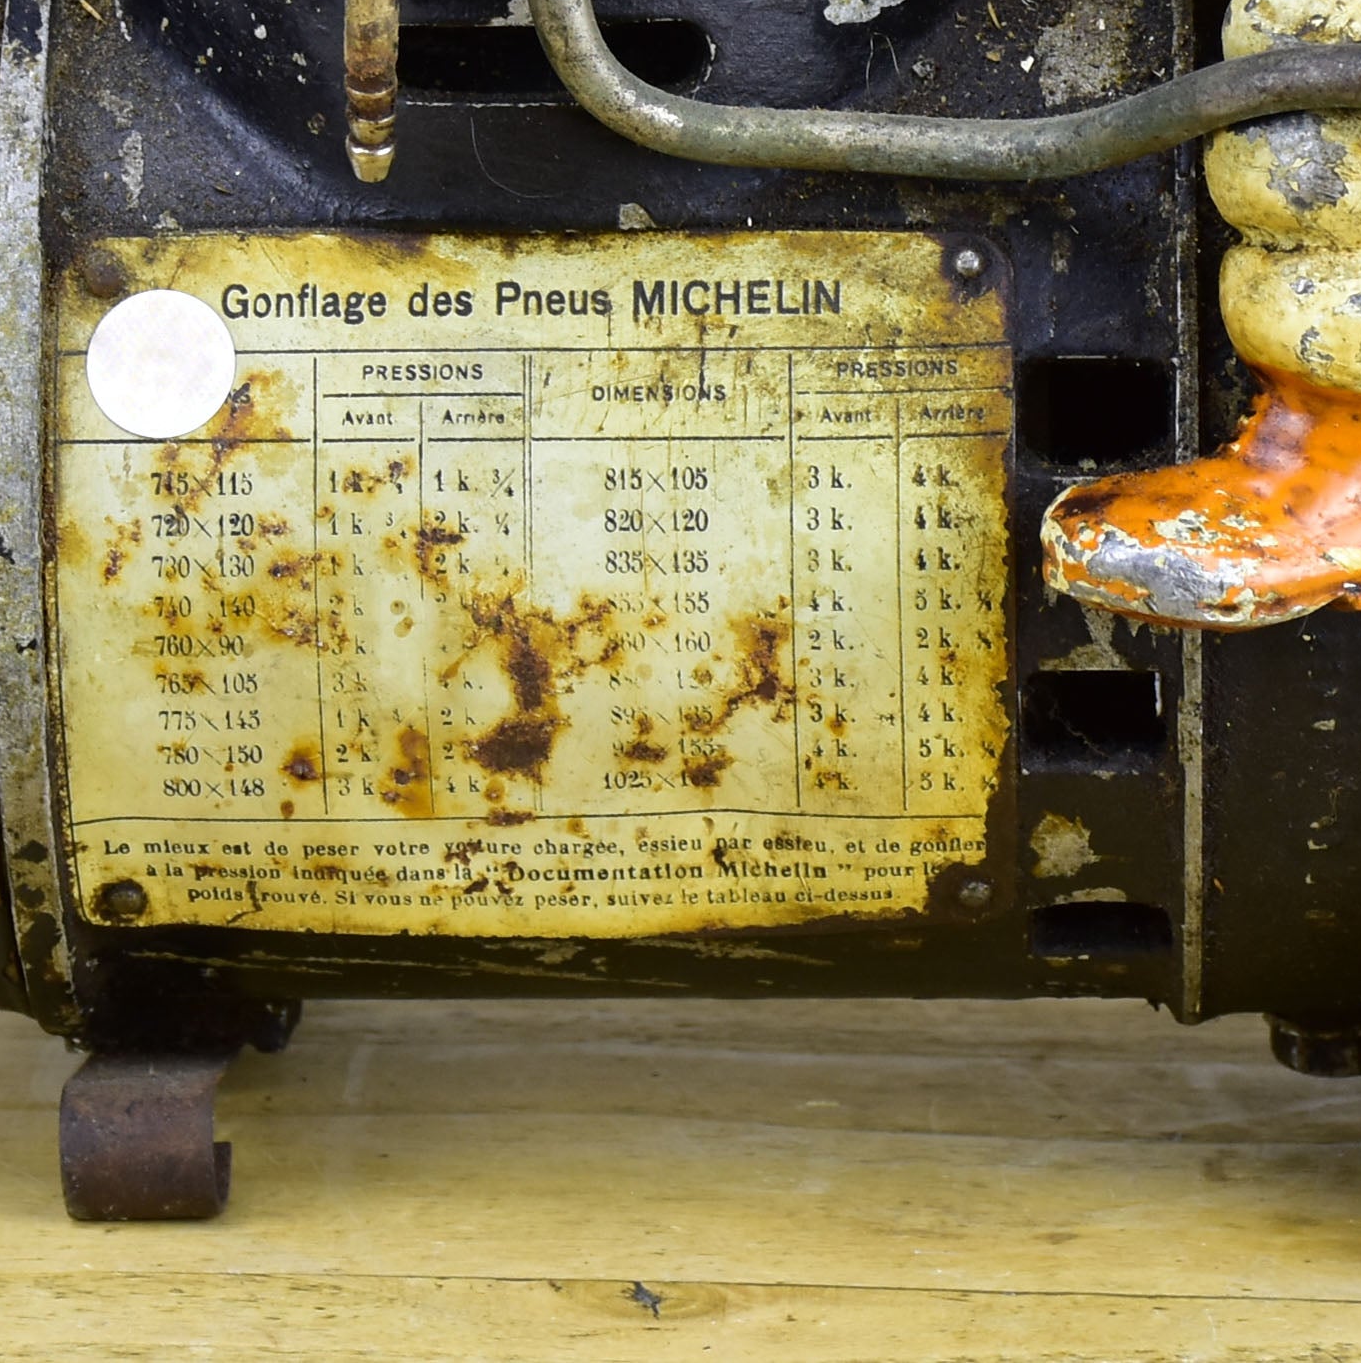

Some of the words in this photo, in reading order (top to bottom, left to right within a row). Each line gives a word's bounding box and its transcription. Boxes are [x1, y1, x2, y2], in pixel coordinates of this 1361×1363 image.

[221, 282, 388, 325] Gonflage
[407, 282, 474, 318] des
[495, 280, 613, 318] Pneus
[632, 279, 842, 317] MICHELIN
[361, 363, 485, 382] PRESSIONS
[836, 359, 959, 379] PRESSIONS
[591, 384, 728, 403] DIMENSIONS
[341, 410, 395, 426] Avant
[819, 407, 873, 425] Avant
[434, 469, 445, 493] 1
[807, 465, 820, 489] 3
[830, 465, 853, 489] k.
[806, 507, 820, 531] 3
[830, 507, 853, 530] k.
[807, 549, 820, 572] 3
[830, 549, 853, 572] k.
[937, 546, 961, 571] k.
[831, 590, 853, 611] k.
[940, 588, 961, 611] k.
[808, 629, 822, 651] 2
[831, 629, 854, 651] k.
[916, 627, 929, 649] 2
[939, 627, 960, 649] k.
[809, 668, 823, 688] 3
[833, 668, 855, 688] k.
[940, 665, 963, 686] k.
[835, 703, 856, 723] k.
[918, 702, 931, 723] 4
[942, 702, 964, 723] k.
[836, 738, 858, 758] k.
[919, 738, 933, 758] 5
[943, 738, 966, 758] k.
[919, 773, 933, 791] 5
[942, 773, 965, 792] k.
[103, 839, 130, 855] Le
[143, 839, 210, 855] mieux
[264, 840, 289, 856] de
[302, 843, 360, 860] peser
[373, 841, 431, 857] votre
[638, 836, 702, 853] essieu
[845, 840, 865, 854] et
[875, 838, 901, 854] de
[146, 864, 157, 877] à
[166, 863, 184, 877] la
[194, 864, 281, 881] pression
[396, 865, 446, 882] dans
[454, 863, 472, 880] la
[718, 862, 827, 879] Michelin
[864, 864, 915, 881] pour
[188, 888, 244, 904] poids
[335, 891, 357, 906] Si
[365, 893, 413, 906] vous
[534, 893, 599, 910] peser,
[707, 888, 787, 905] tableau
